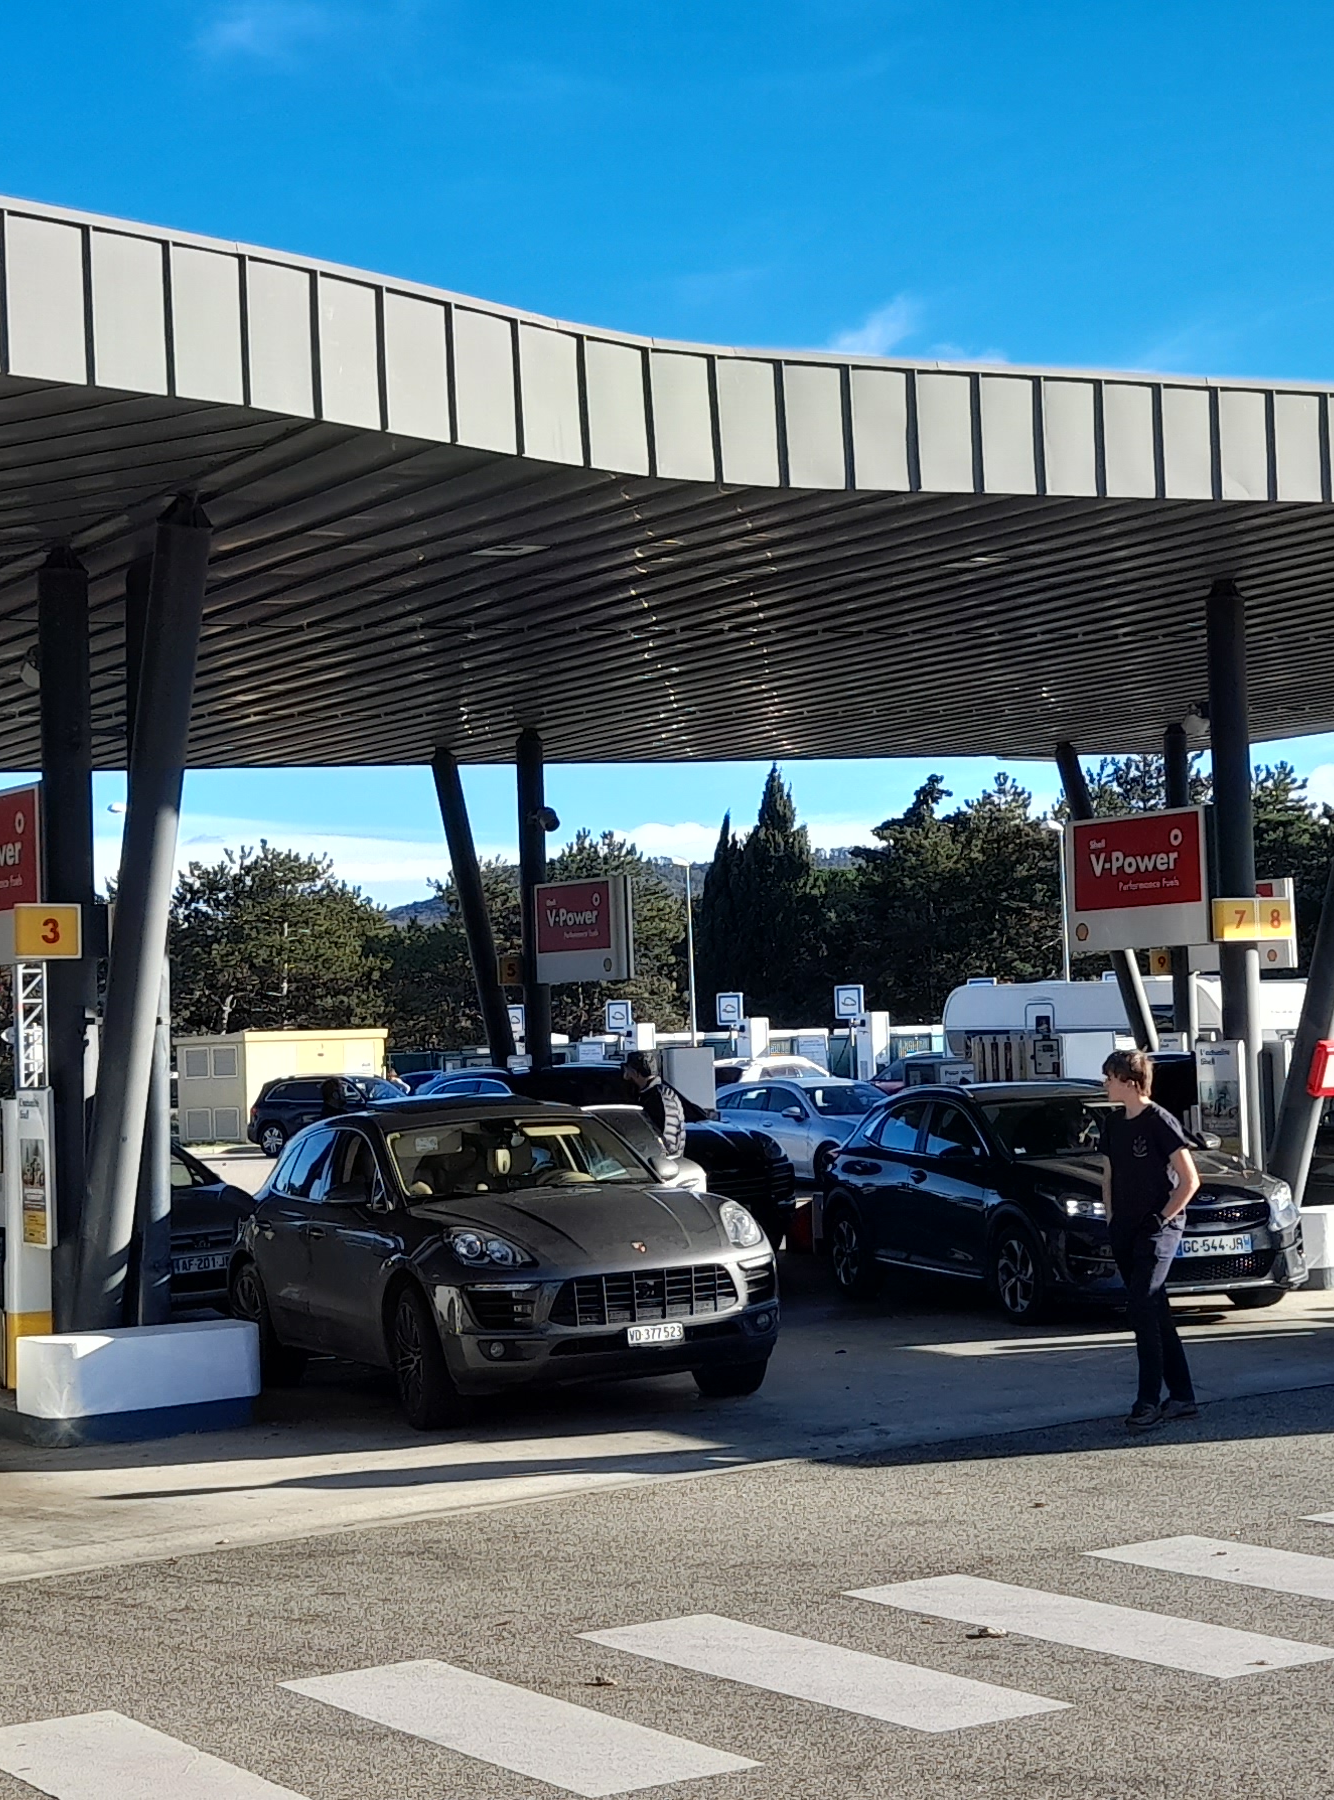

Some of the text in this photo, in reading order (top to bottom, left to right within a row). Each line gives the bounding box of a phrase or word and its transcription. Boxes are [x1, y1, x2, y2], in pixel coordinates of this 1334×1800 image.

[1089, 838, 1106, 850] Shell
[1090, 851, 1178, 877] V-Power
[1119, 880, 1160, 892] Performance
[546, 907, 598, 927] V-Power
[1234, 910, 1246, 929] 7
[1270, 909, 1281, 929] 8
[41, 918, 60, 944] 3
[507, 963, 516, 977] 5
[1157, 956, 1166, 968] 9
[181, 1254, 230, 1272] AF-201-J
